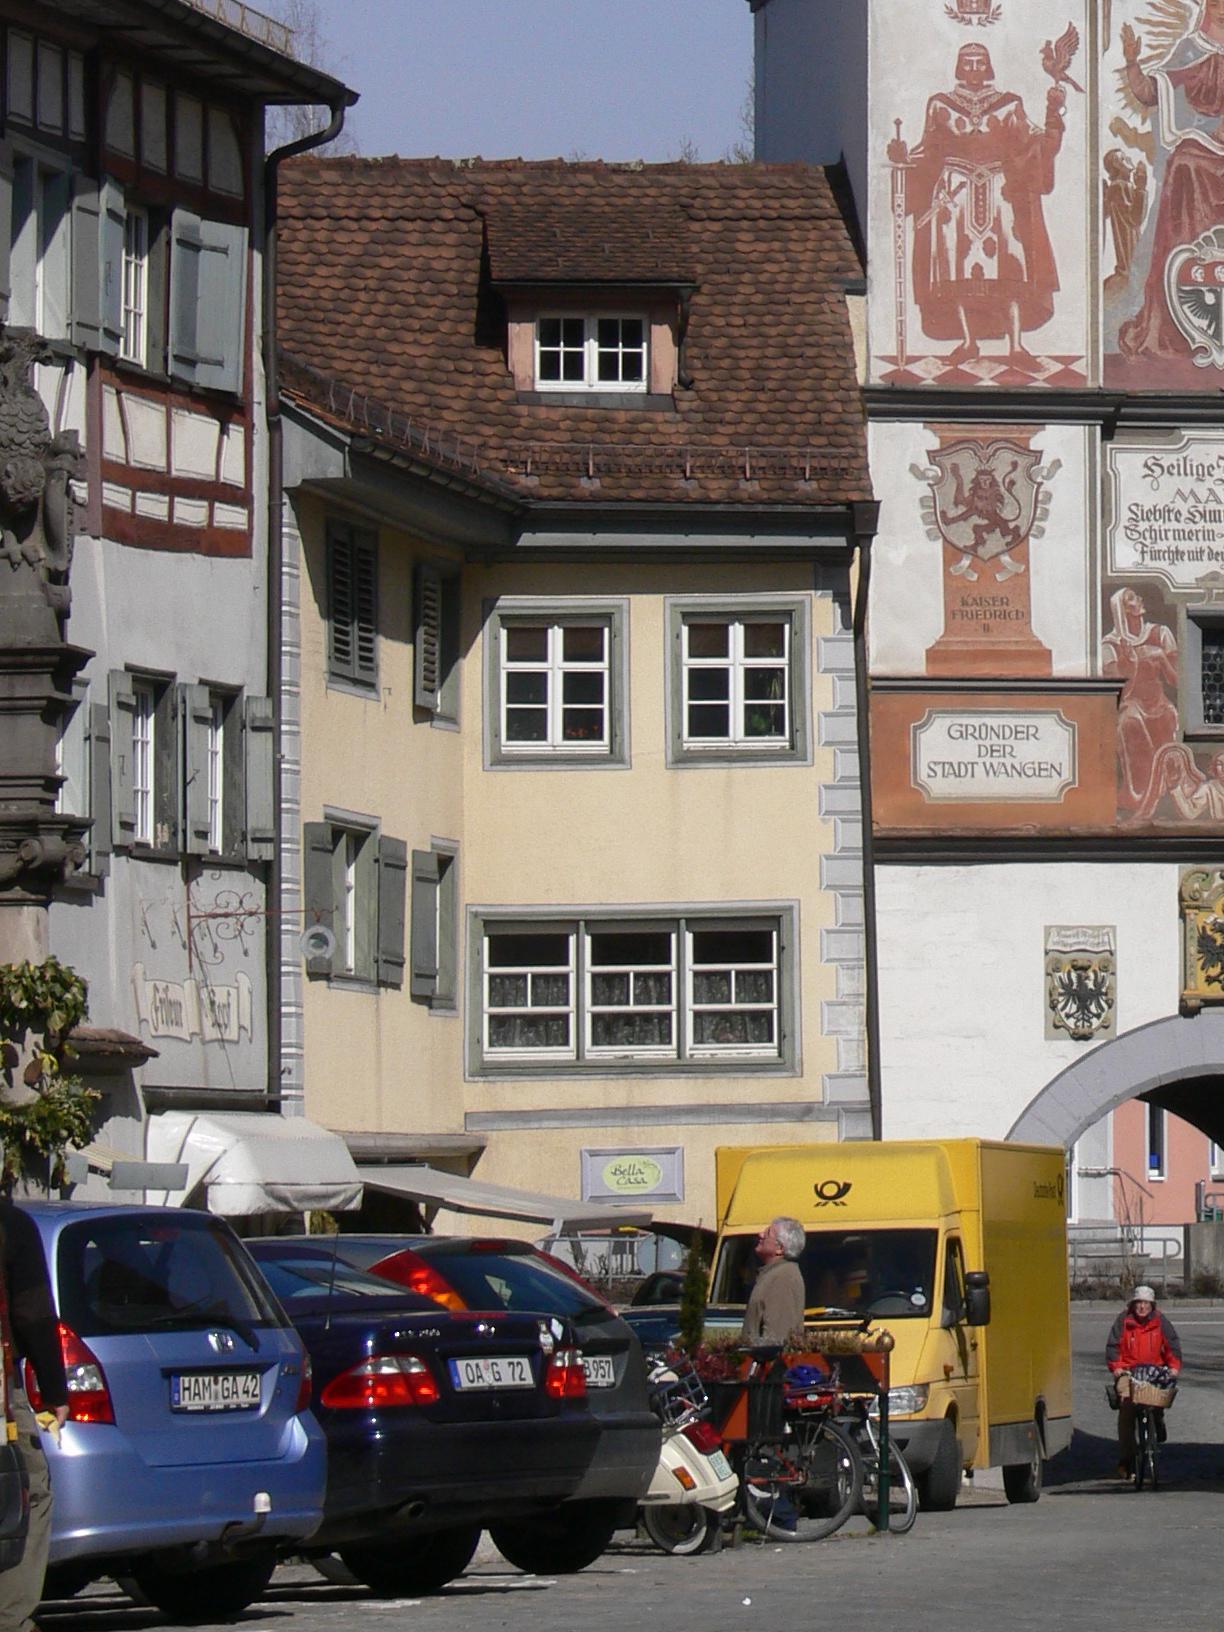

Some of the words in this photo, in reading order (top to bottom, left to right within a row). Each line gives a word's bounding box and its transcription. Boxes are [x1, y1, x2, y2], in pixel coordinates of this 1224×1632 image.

[1142, 455, 1215, 491] Heilige
[1127, 502, 1182, 525] Liebste
[1124, 524, 1216, 546] Schirmerin
[1134, 542, 1186, 567] Fürchte
[1207, 546, 1224, 564] der
[961, 595, 1010, 608] KAISER
[947, 723, 1040, 742] GRÜNDER
[977, 744, 1017, 759] DER
[927, 761, 979, 778] STADT
[982, 761, 1063, 778] WANGEN
[611, 1164, 646, 1177] Bella
[616, 1176, 648, 1186] Casa
[465, 1362, 484, 1384] OA
[492, 1361, 503, 1382] G
[508, 1361, 526, 1382] 72
[592, 1359, 611, 1379] 957
[182, 1377, 213, 1402] HAM
[221, 1377, 240, 1400] GA
[243, 1375, 259, 1398] 42
